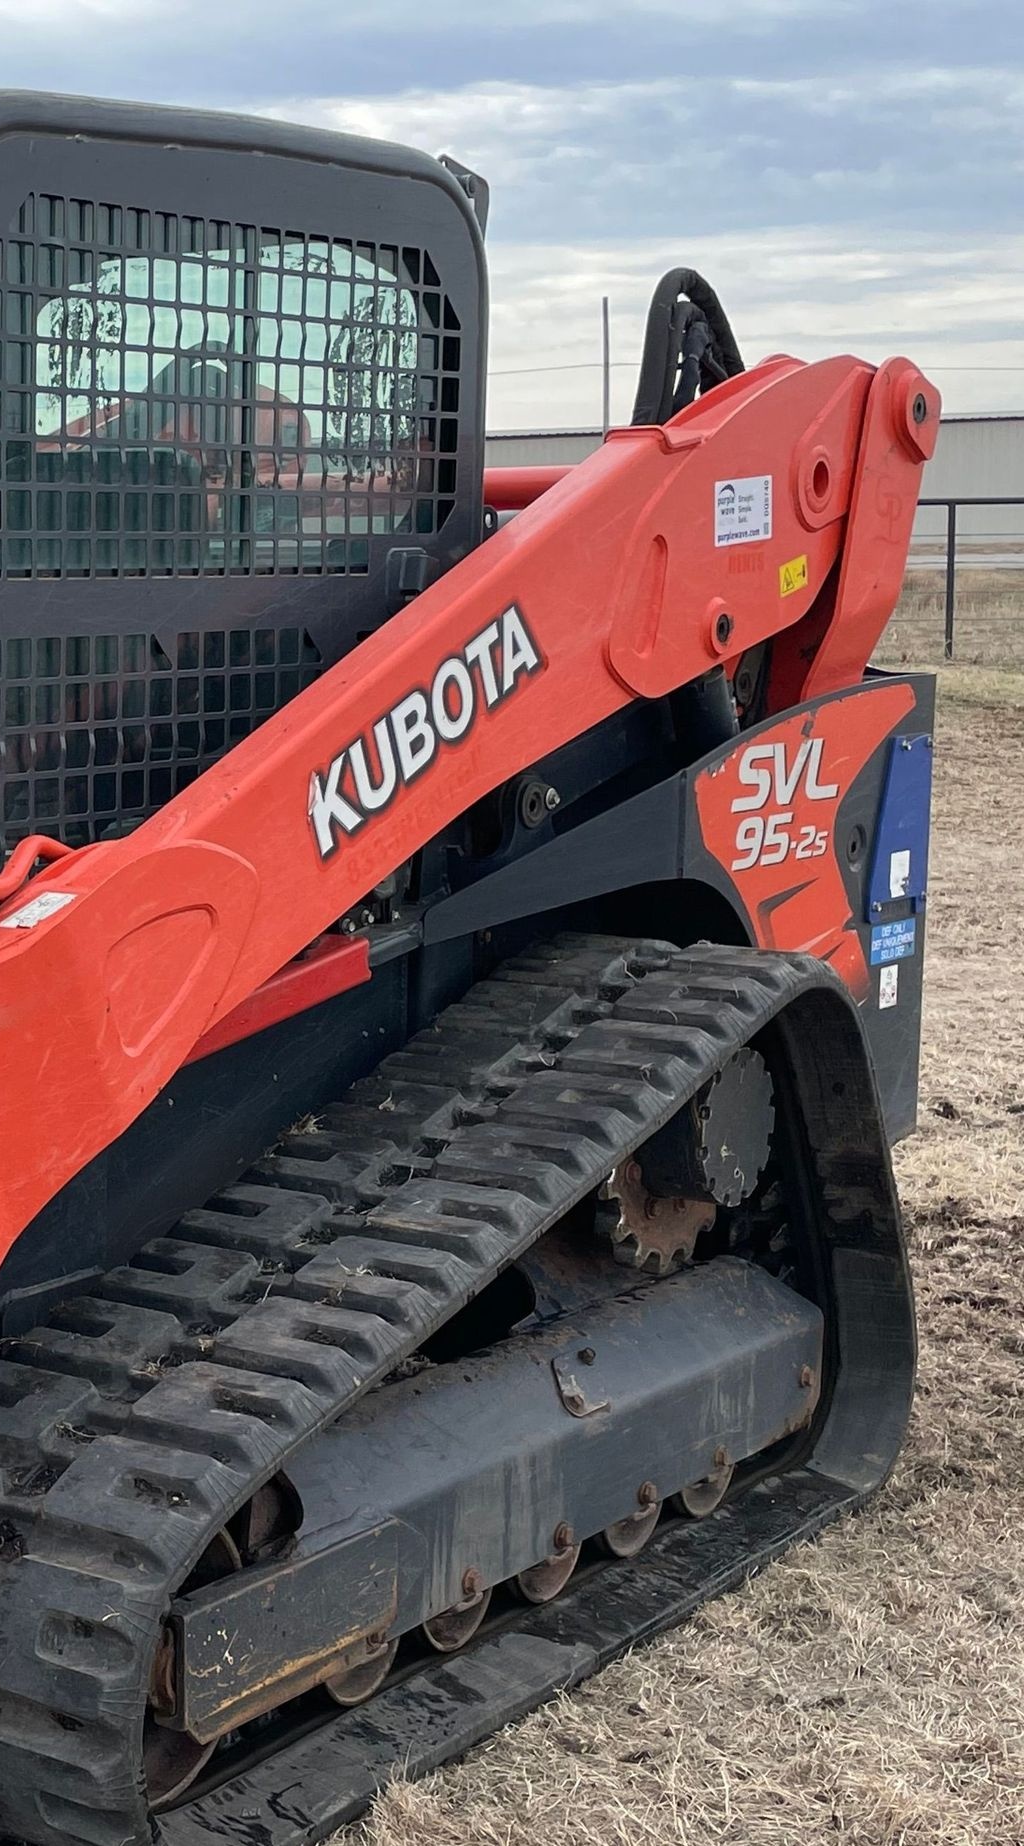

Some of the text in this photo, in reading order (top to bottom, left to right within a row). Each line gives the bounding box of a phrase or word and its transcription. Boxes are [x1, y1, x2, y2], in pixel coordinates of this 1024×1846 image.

[721, 507, 735, 515] wave
[717, 528, 760, 543] purplewave.com
[308, 604, 539, 858] KUBOTA
[731, 738, 840, 813] SVL
